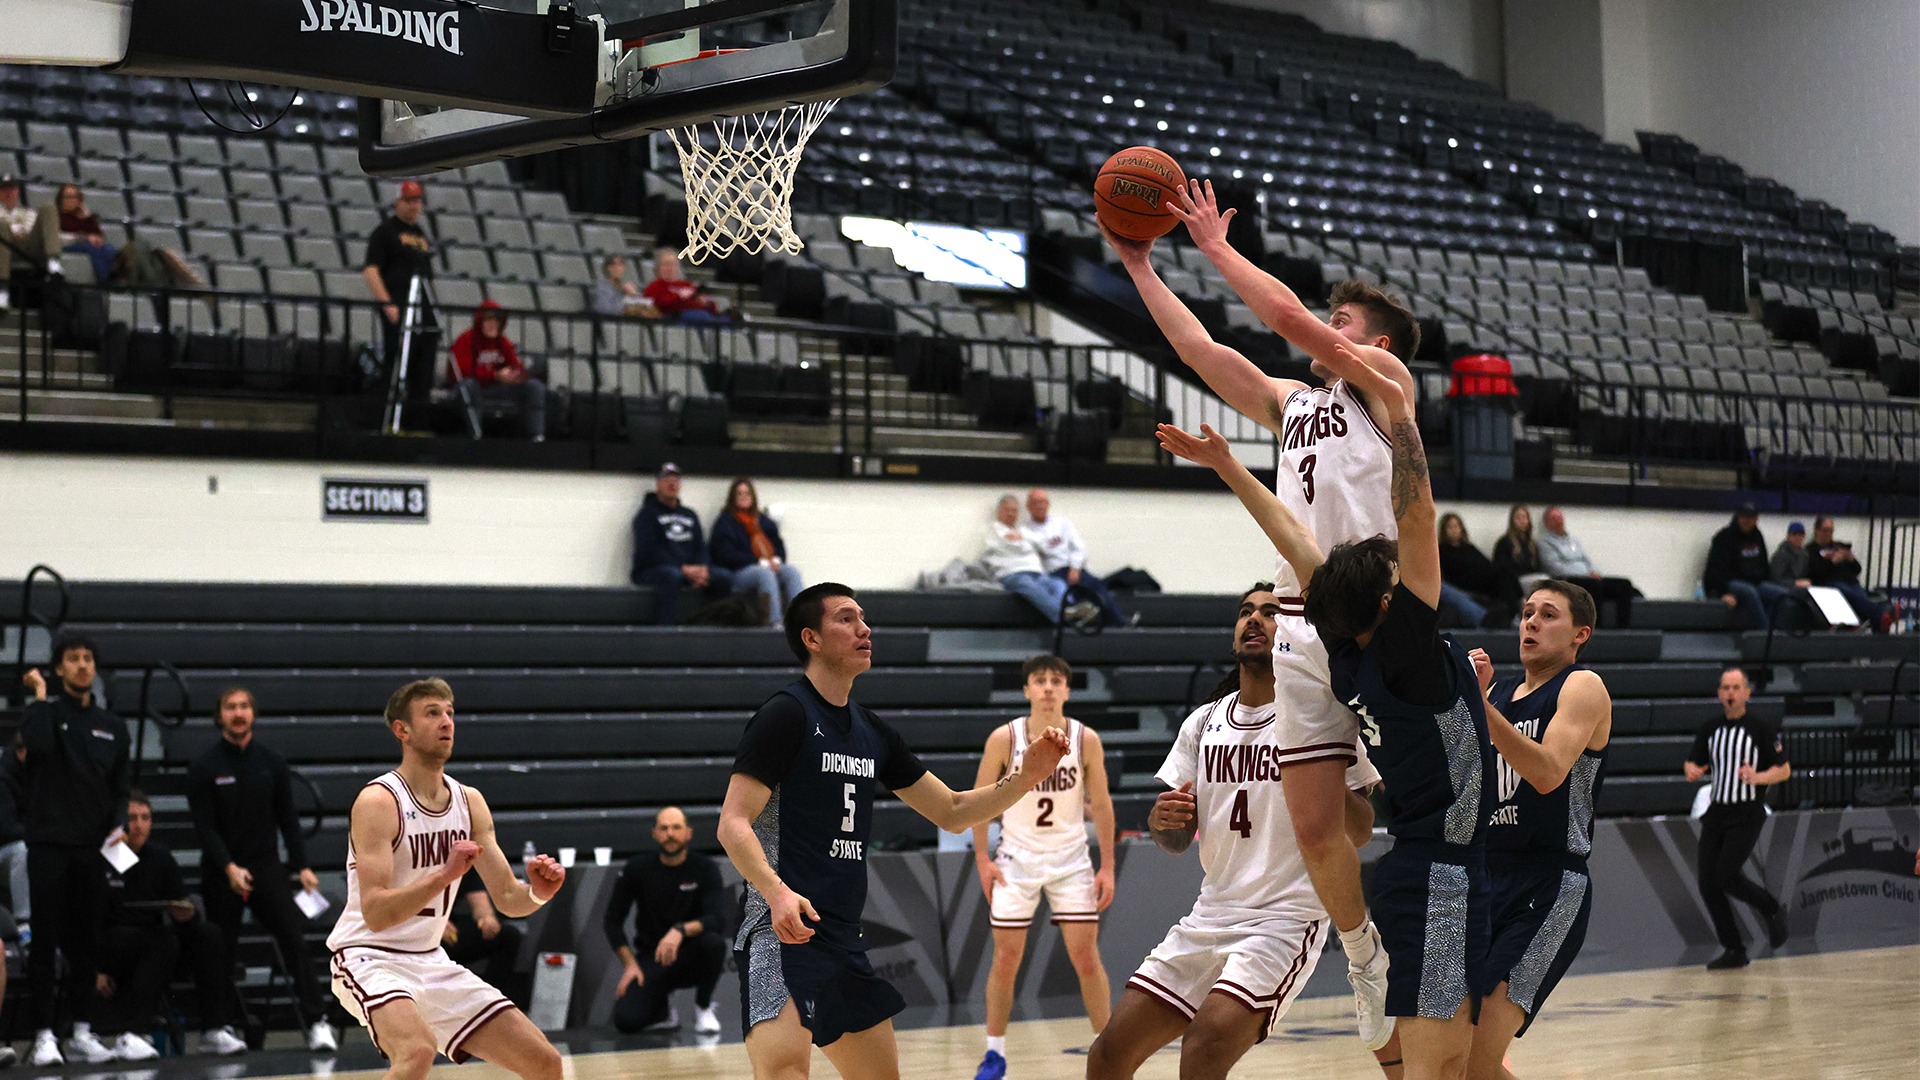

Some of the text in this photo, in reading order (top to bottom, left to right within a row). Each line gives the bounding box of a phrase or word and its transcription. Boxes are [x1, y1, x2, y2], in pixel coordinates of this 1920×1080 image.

[300, 0, 460, 55] SPALDING
[1114, 156, 1175, 184] SPALDING
[1111, 177, 1161, 209] NAIA
[1281, 403, 1348, 453] VIKIGS
[1298, 455, 1317, 505] 3
[327, 487, 424, 514] SECTION 3
[821, 752, 875, 778] DICKINSON
[1204, 744, 1282, 784] VIKINGS
[841, 783, 856, 832] 5
[1036, 798, 1054, 827] 2
[1230, 790, 1252, 838] 4
[829, 839, 862, 860] STATE
[1801, 882, 1878, 908] Jamestown
[1882, 880, 1914, 902] Civic
